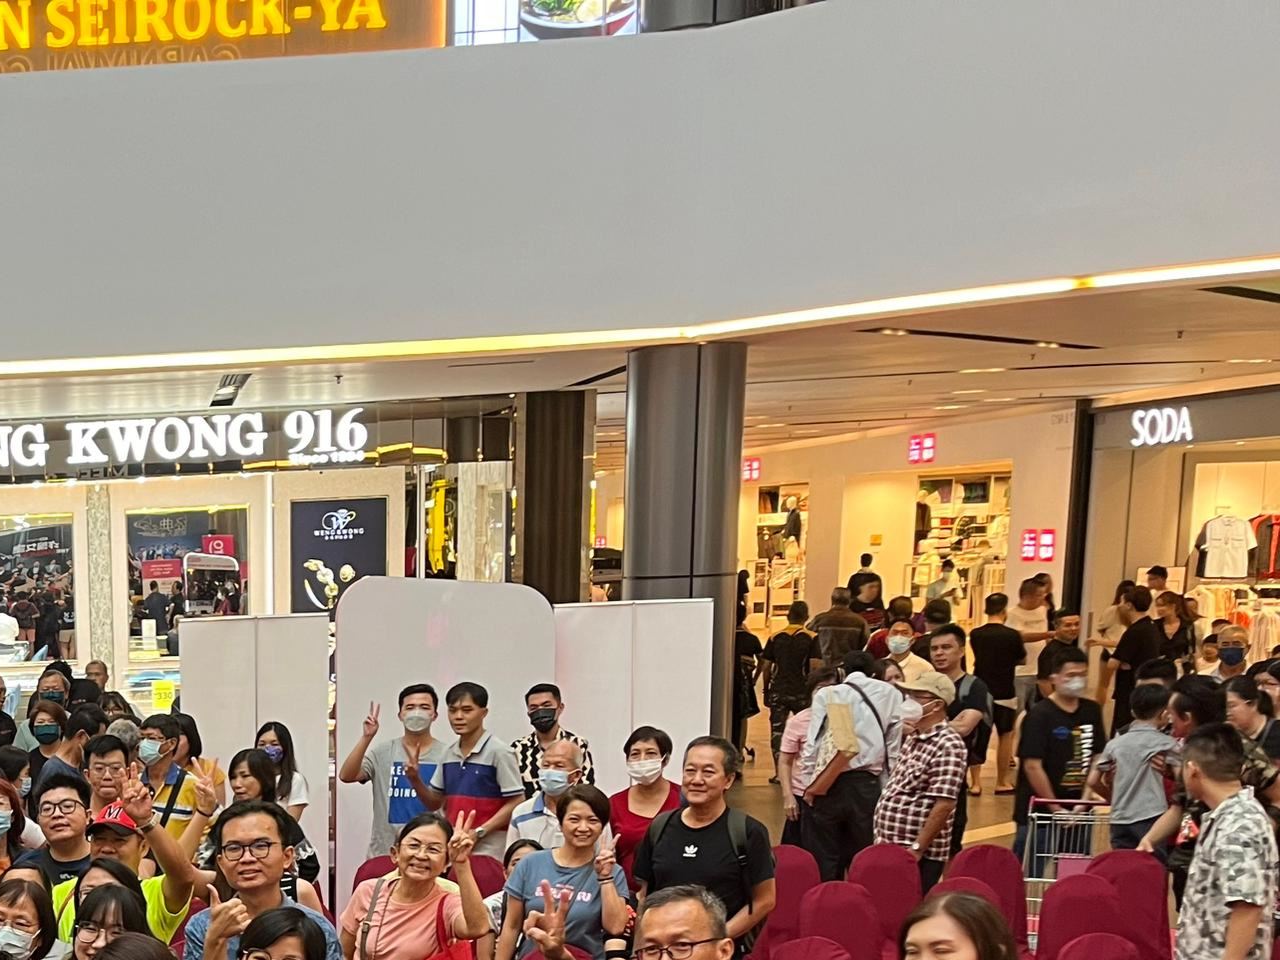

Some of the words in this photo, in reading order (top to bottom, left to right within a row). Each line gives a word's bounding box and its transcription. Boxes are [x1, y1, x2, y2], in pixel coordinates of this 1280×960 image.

[46, 0, 387, 48] SEIROCK-YA
[66, 412, 268, 463] KWONG
[284, 407, 368, 453] 916
[1130, 407, 1193, 446] SODA
